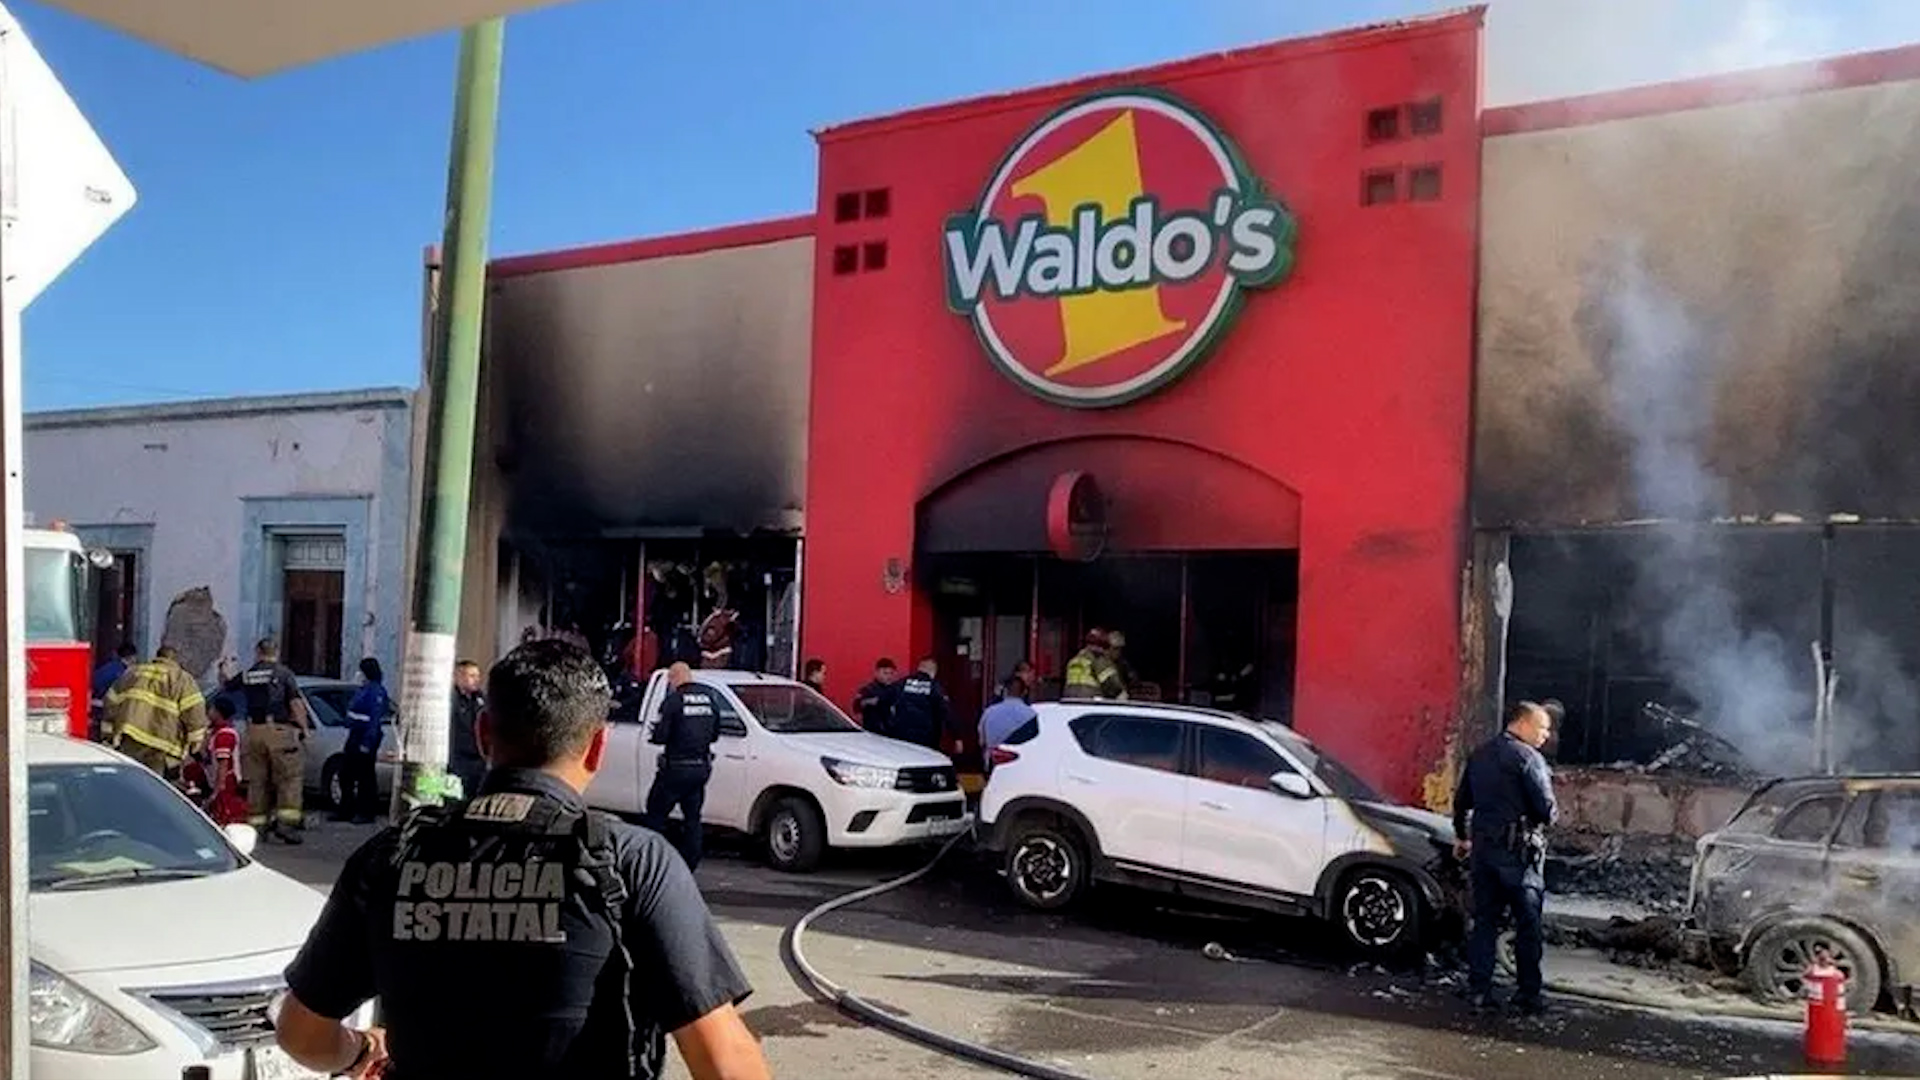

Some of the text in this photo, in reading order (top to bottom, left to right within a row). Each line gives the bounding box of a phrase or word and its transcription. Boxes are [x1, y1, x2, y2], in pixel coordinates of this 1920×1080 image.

[946, 195, 1277, 300] Waldo's
[1011, 107, 1187, 377] 1
[393, 900, 567, 942] ESTATAL
